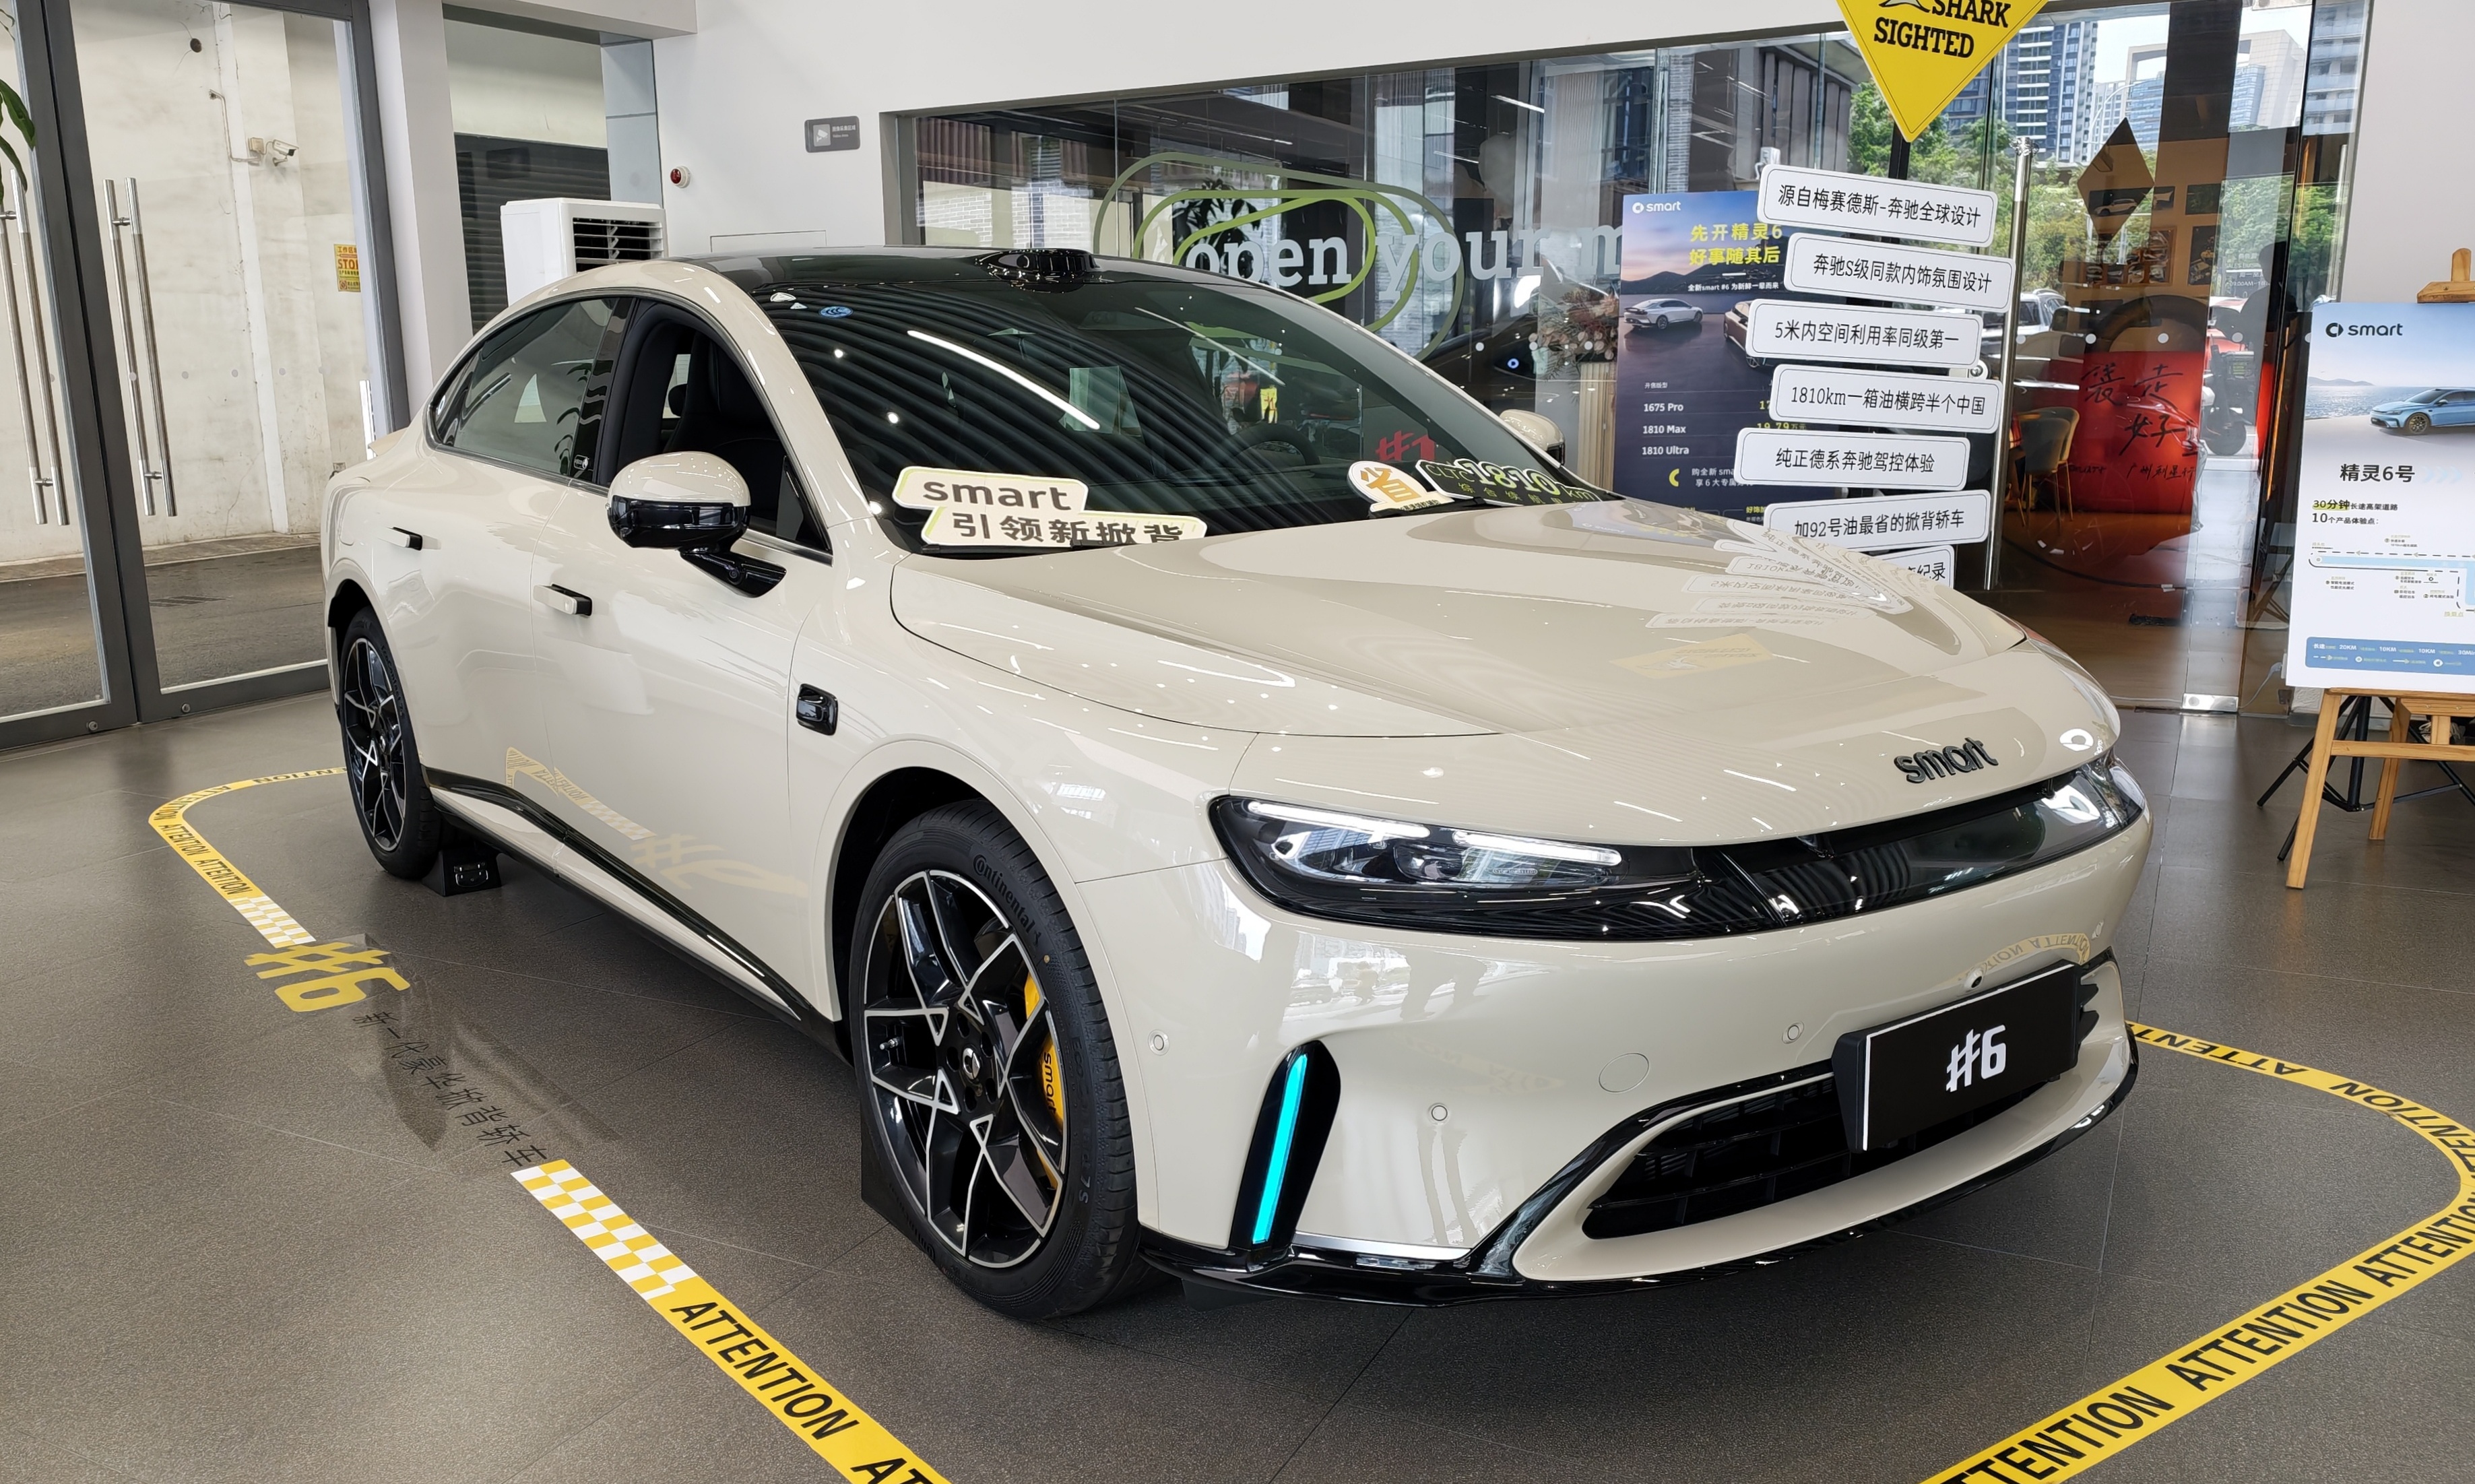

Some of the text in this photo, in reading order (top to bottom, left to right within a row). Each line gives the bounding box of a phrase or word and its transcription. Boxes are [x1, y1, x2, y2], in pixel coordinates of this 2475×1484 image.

[1932, 0, 2012, 28] SHARK
[1873, 17, 1974, 59] SIGHTED
[1646, 201, 1681, 212] smart
[1778, 185, 1981, 228] 源自梅赛德斯-奔驰全球设计
[1690, 222, 1782, 243] 先开精灵6
[1186, 236, 1351, 289] open
[1375, 226, 1549, 300] your
[1689, 246, 1781, 266] 好事随其后
[1813, 253, 1992, 294] 奔驰S级同款内饰氛围设计
[1774, 319, 1959, 350] 5米内空间利用率同级第一
[2348, 323, 2403, 336] smart
[1644, 402, 1683, 412] 1675 Pro
[1791, 387, 1985, 415] 1810km一箱油横跨半个中国
[1642, 425, 1686, 434] 1810 Max
[1642, 445, 1689, 455] 1810 Ultra
[1775, 447, 1935, 473] 纯正德系奔驰驾控体验
[1360, 466, 1422, 503] 省
[1426, 462, 1596, 501] CLTC 1810 km
[2340, 463, 2415, 482] 精灵6号
[923, 480, 1072, 511] smart
[1458, 482, 1578, 505] 综合续航里
[952, 513, 1183, 544] 引领新掀背
[1795, 509, 1965, 538] 加92号油最省的掀背轿车
[1894, 737, 1999, 783] smart
[154, 786, 231, 820] ATTENTION
[158, 824, 211, 856] ATTENTION
[194, 859, 253, 895] ATTENTION
[973, 854, 1035, 934] Continental
[243, 942, 411, 1012] #6
[1946, 1025, 2007, 1093] #6
[2129, 1024, 2309, 1076] ATTENT
[352, 1011, 547, 1167] 新一代豪华掀背轿车
[1041, 1052, 1058, 1115] smart
[2352, 1192, 2475, 1287] ATTENTIO
[2164, 1279, 2375, 1391] ATTENTION
[670, 1302, 860, 1441] ATTENTION
[1940, 1386, 2175, 1484] TENTION
